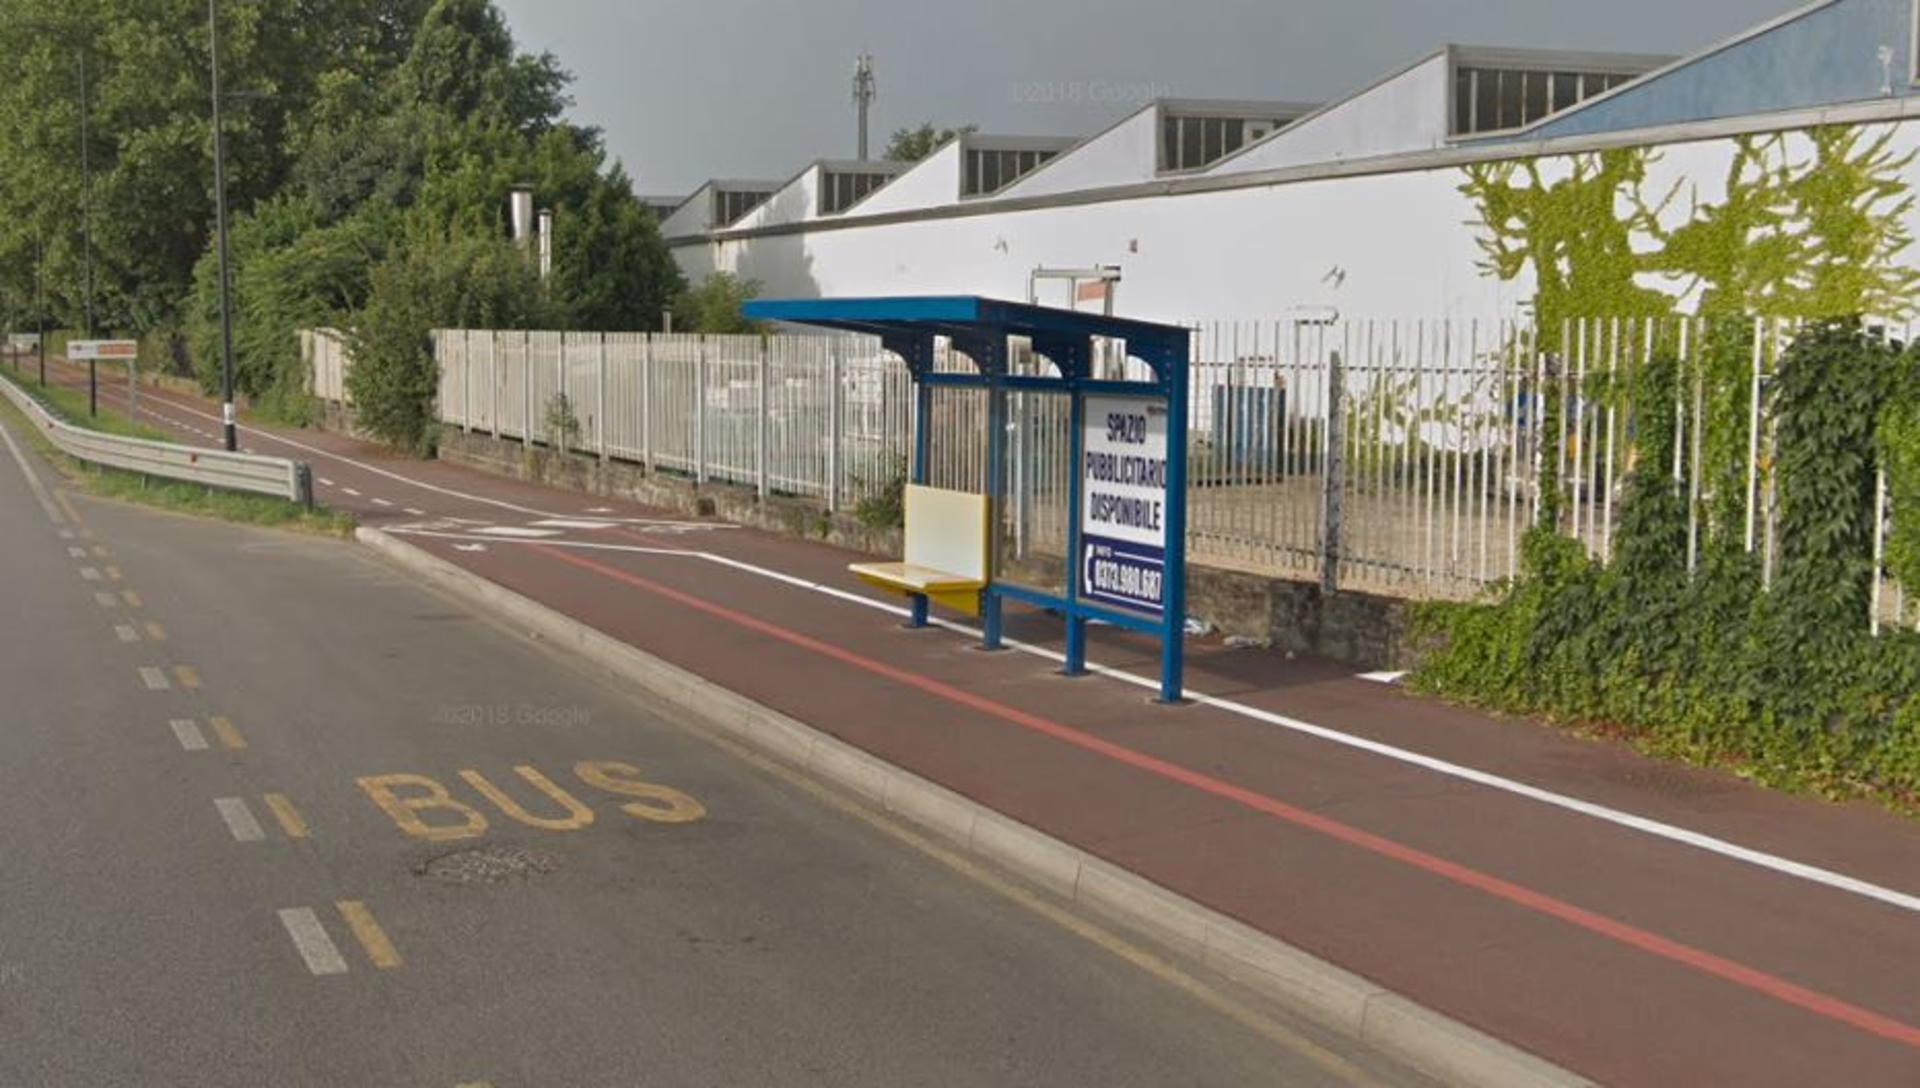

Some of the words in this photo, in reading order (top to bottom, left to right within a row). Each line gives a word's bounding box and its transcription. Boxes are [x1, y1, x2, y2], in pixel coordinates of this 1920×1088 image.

[1107, 412, 1145, 444] SPAZIO
[1091, 493, 1160, 531] DISPONIBILE
[355, 760, 706, 842] BUS
